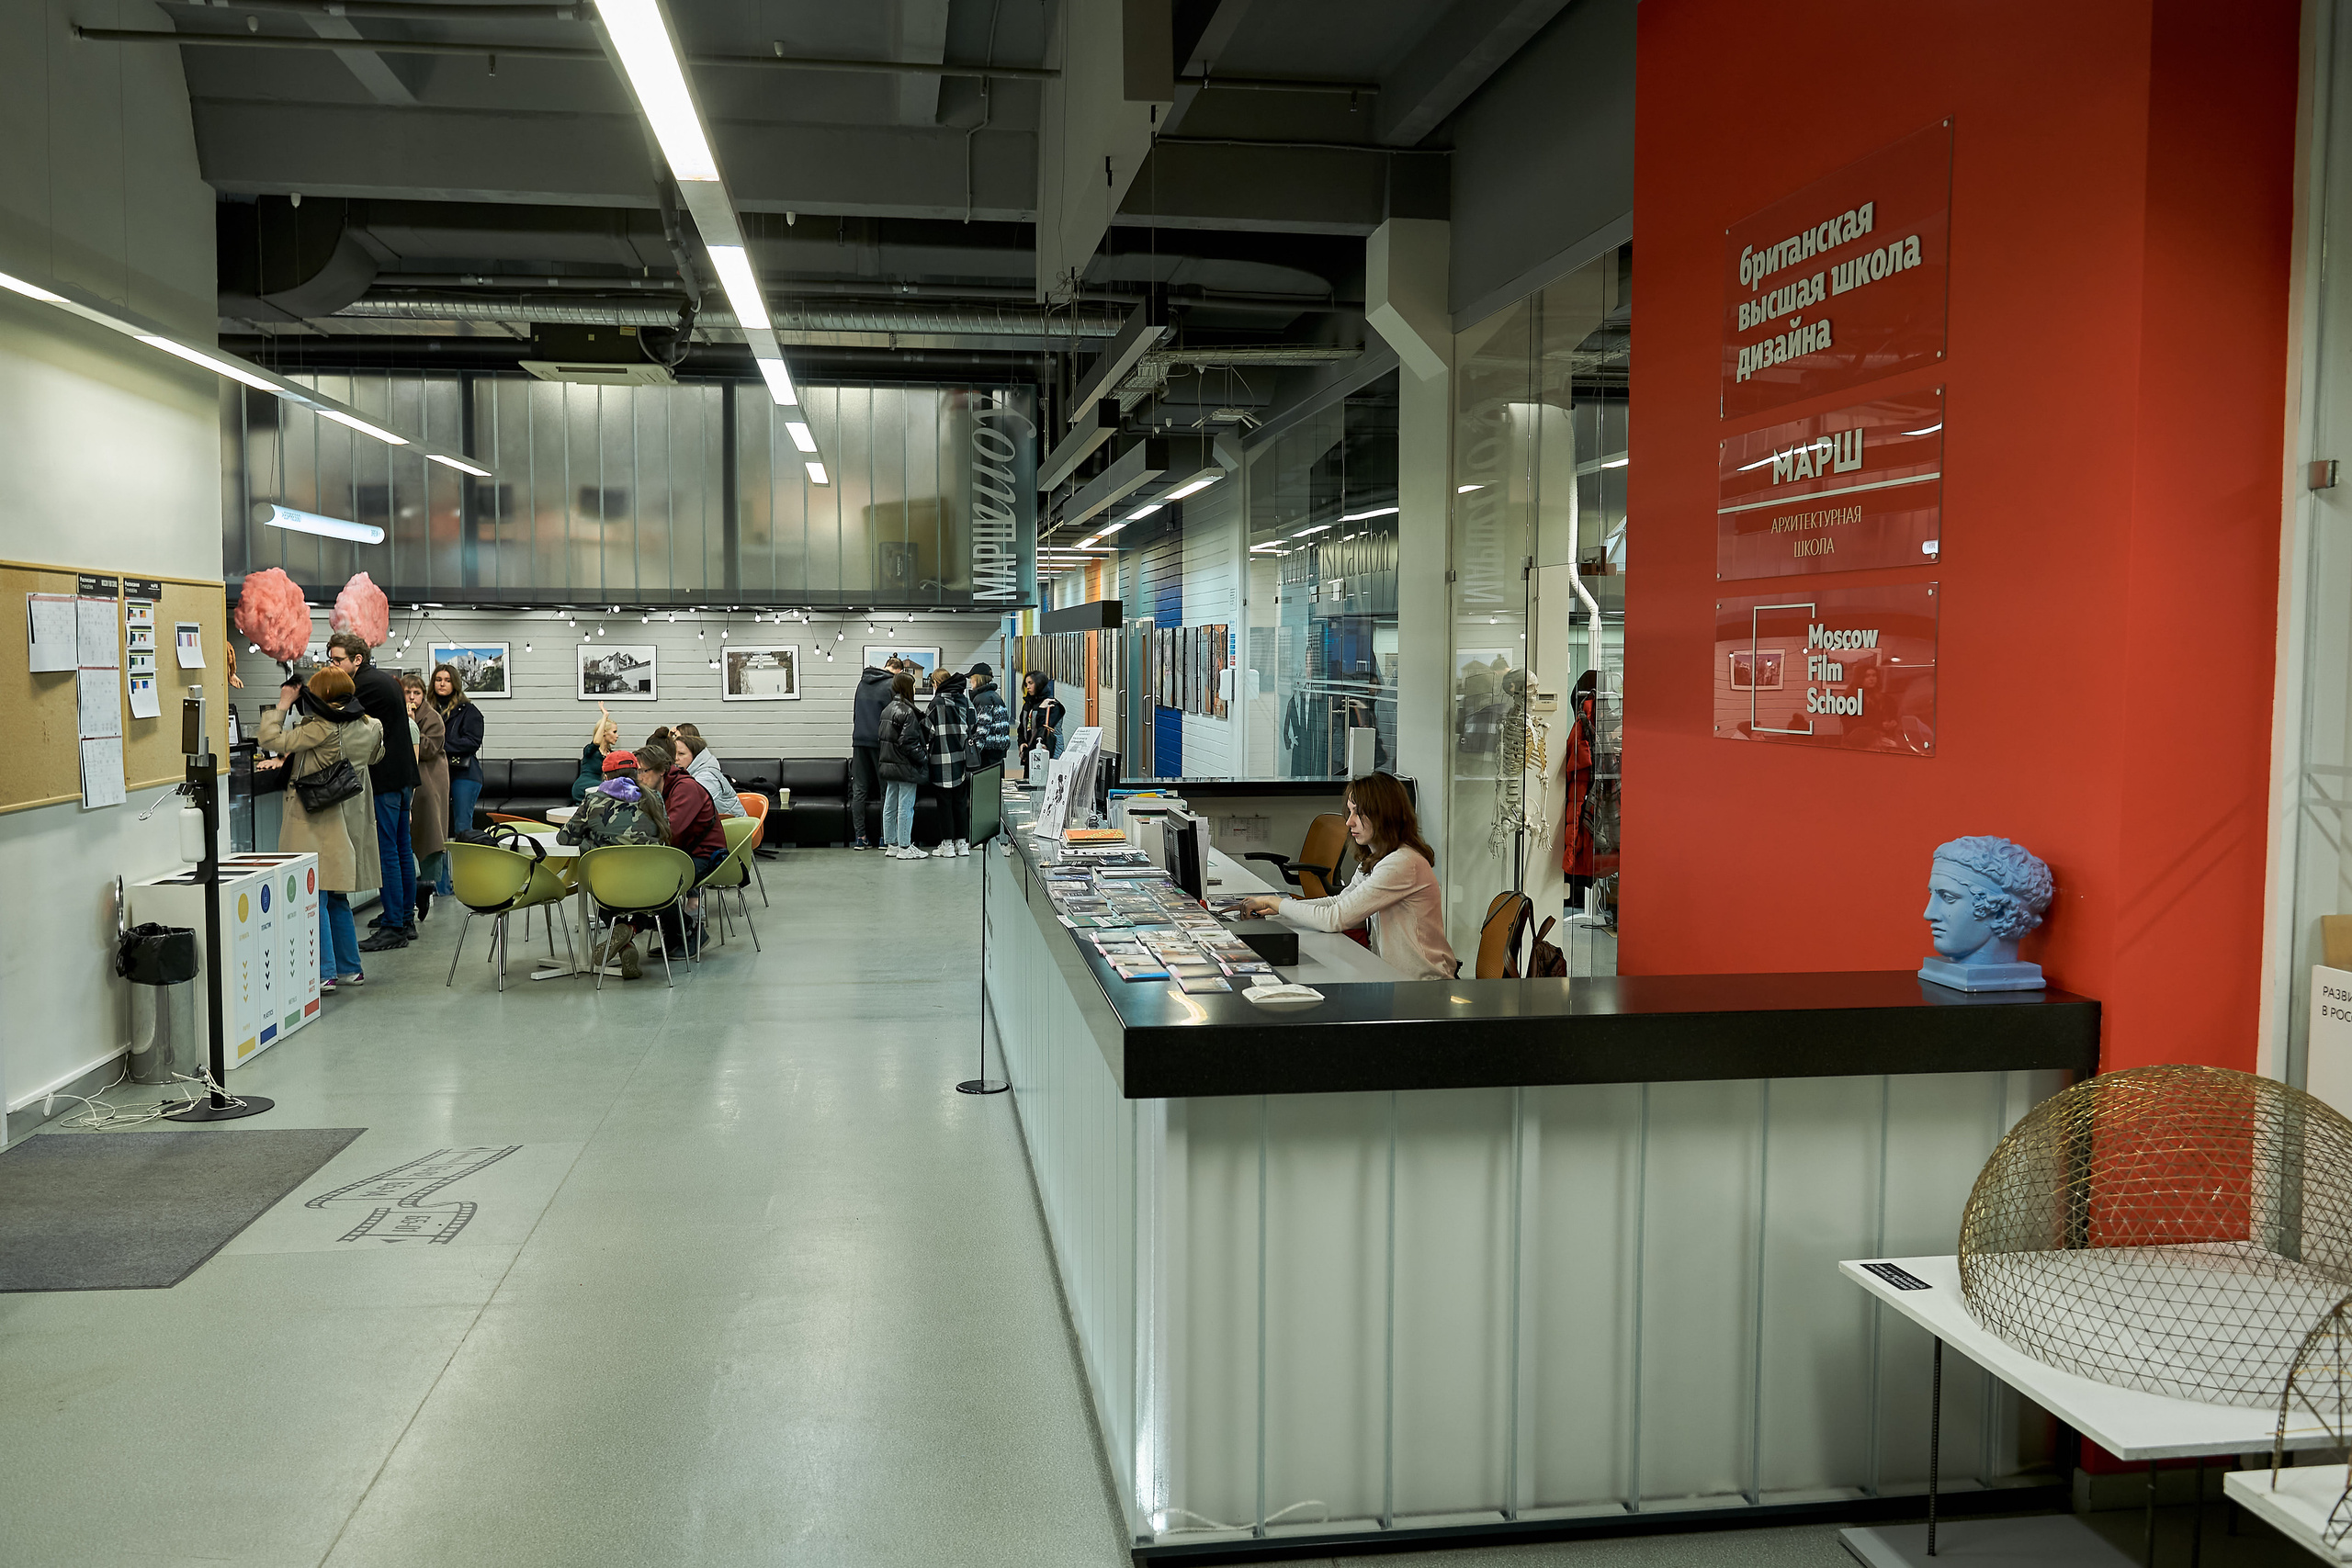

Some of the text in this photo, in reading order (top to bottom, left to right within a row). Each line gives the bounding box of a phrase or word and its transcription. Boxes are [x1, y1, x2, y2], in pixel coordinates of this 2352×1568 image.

[1739, 201, 1874, 291] британская
[1737, 234, 1922, 333] высшая школа
[1736, 316, 1832, 384] дизайна
[1771, 427, 1864, 485] МАРШ
[1770, 504, 1862, 534] АРХИТЕКТУРНАЯ
[1792, 537, 1835, 558] ШКОЛА
[1807, 623, 1879, 649] Moscow
[1807, 656, 1844, 682] Film
[1806, 687, 1864, 716] School
[2322, 1005, 2352, 1022] В РОС
